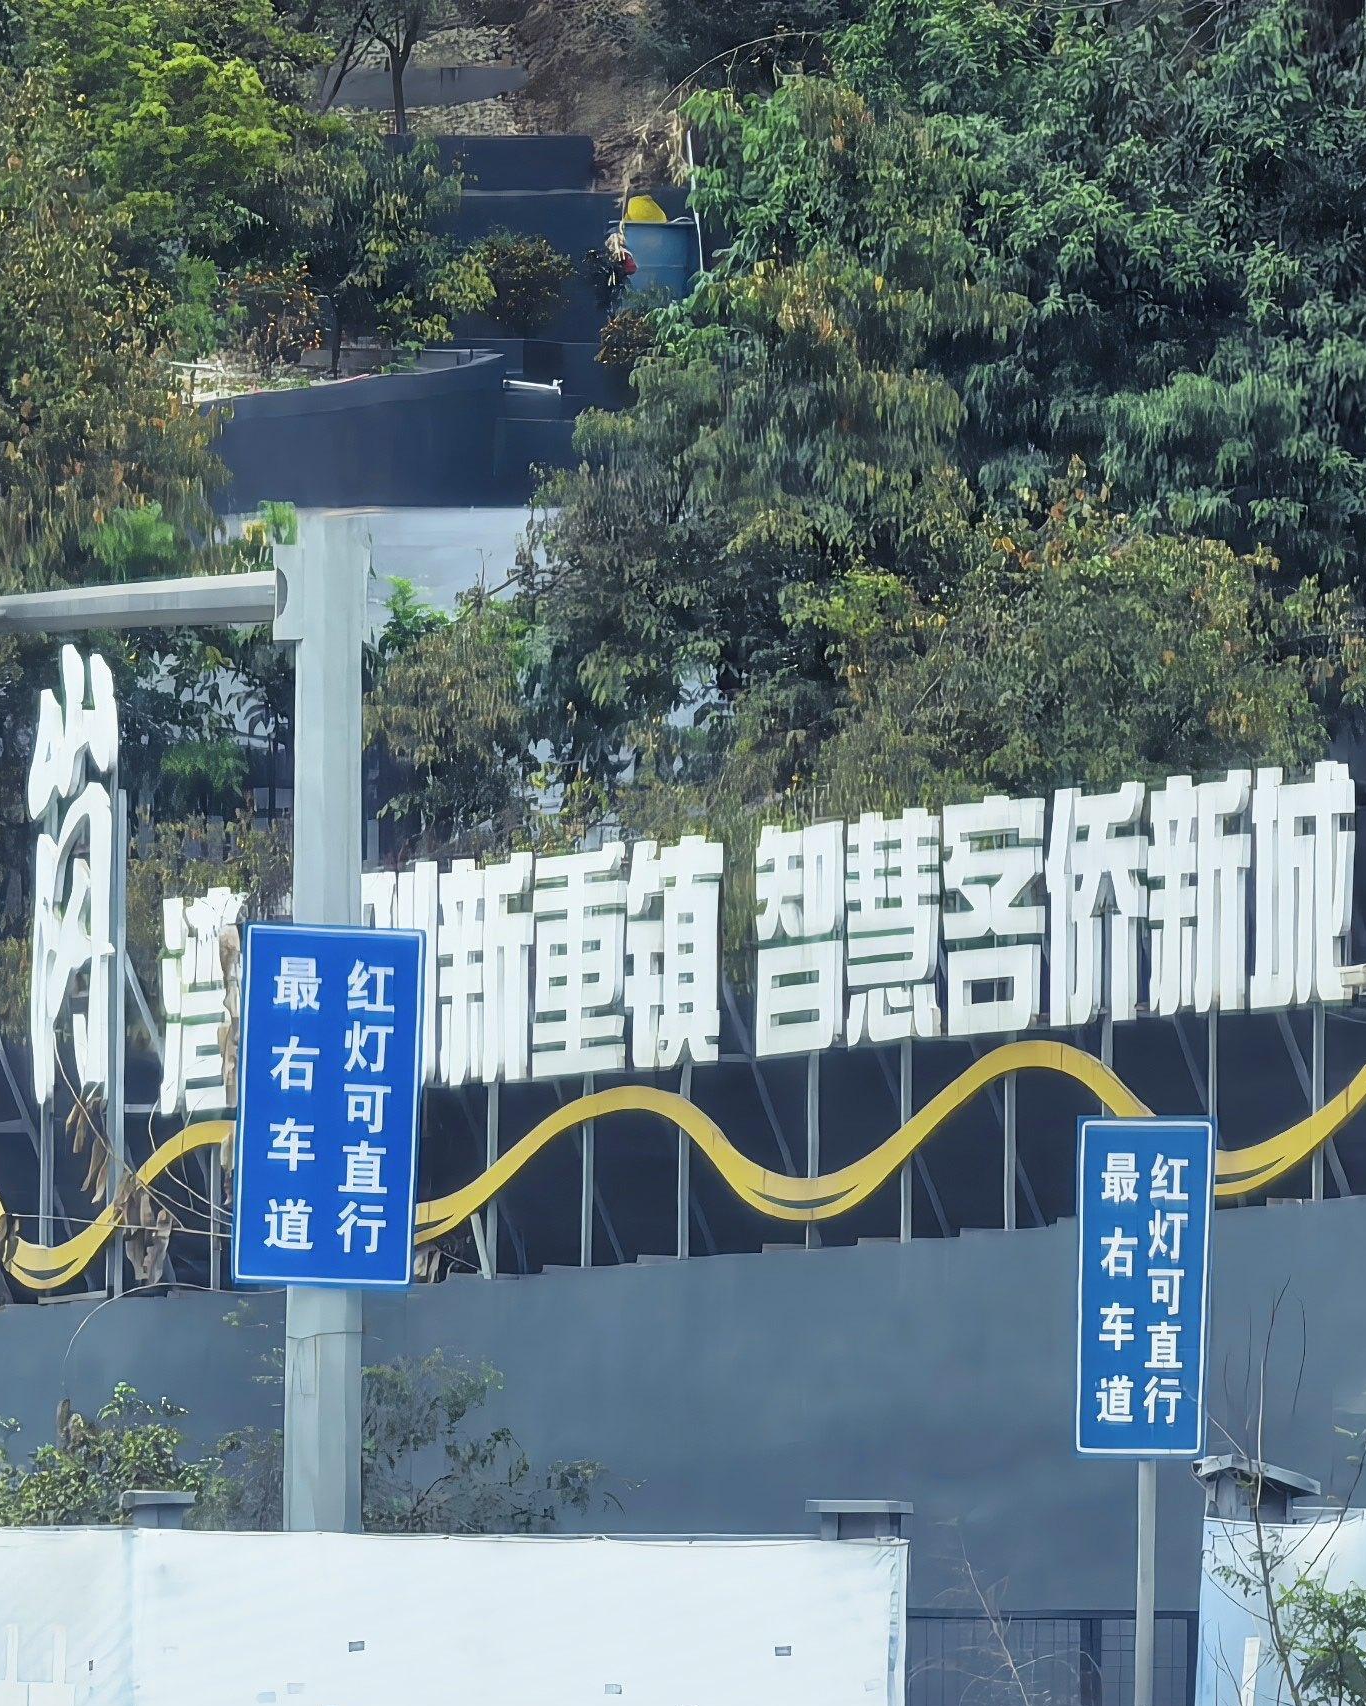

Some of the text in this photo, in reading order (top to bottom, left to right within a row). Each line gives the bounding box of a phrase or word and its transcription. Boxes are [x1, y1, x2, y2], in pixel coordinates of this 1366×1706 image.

[161, 761, 1357, 1115] 湾新重镇 智慧客侨新城
[264, 956, 323, 1251] 最右车道
[337, 959, 396, 1254] 红灯可直行
[1096, 1153, 1140, 1425] 最右车道
[1143, 1154, 1189, 1425] 红灯可直行
